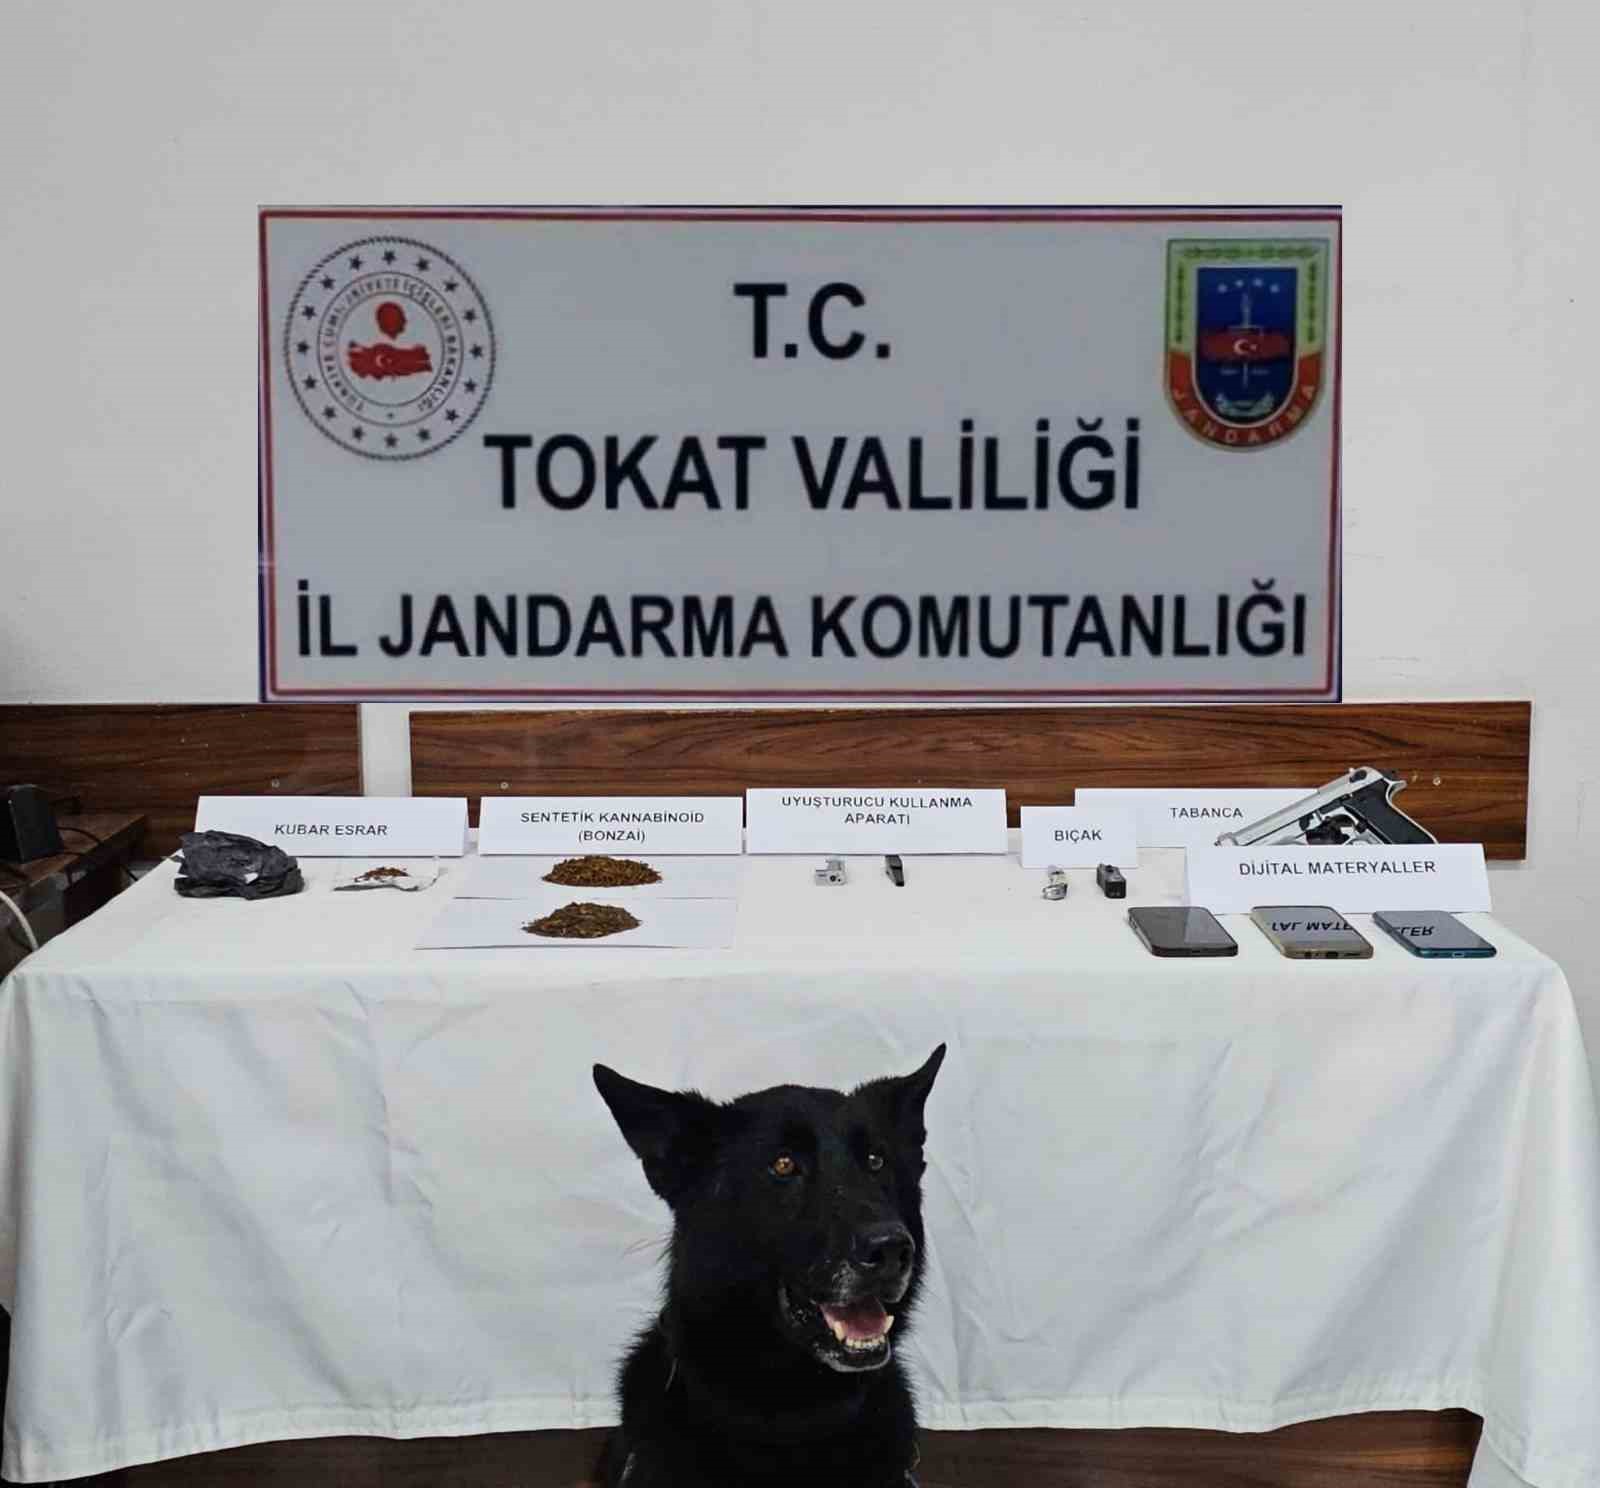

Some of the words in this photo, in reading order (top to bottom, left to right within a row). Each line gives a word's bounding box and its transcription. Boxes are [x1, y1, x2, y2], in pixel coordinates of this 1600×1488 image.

[733, 282, 891, 360] T.C.
[483, 433, 767, 511] TOKAT
[791, 417, 1140, 511] VALİLİĞİ
[298, 579, 358, 657] İL
[379, 594, 789, 658] JANDARMA
[811, 578, 1306, 659] KOMUTANLIĞI
[781, 796, 885, 809] UYUŞTURUCU
[889, 797, 972, 808] KULLANMA
[520, 810, 594, 823] SENTETİK
[599, 810, 704, 823] KANNABİNOİD
[844, 812, 910, 825] APARATI
[1170, 807, 1244, 818] TABANCA
[274, 824, 329, 836] KUBAR
[334, 824, 388, 836] ESRAR
[1054, 829, 1102, 843] BIÇAK
[1239, 861, 1302, 876] DİJİTAL
[1308, 860, 1436, 876] MATERYALLER
